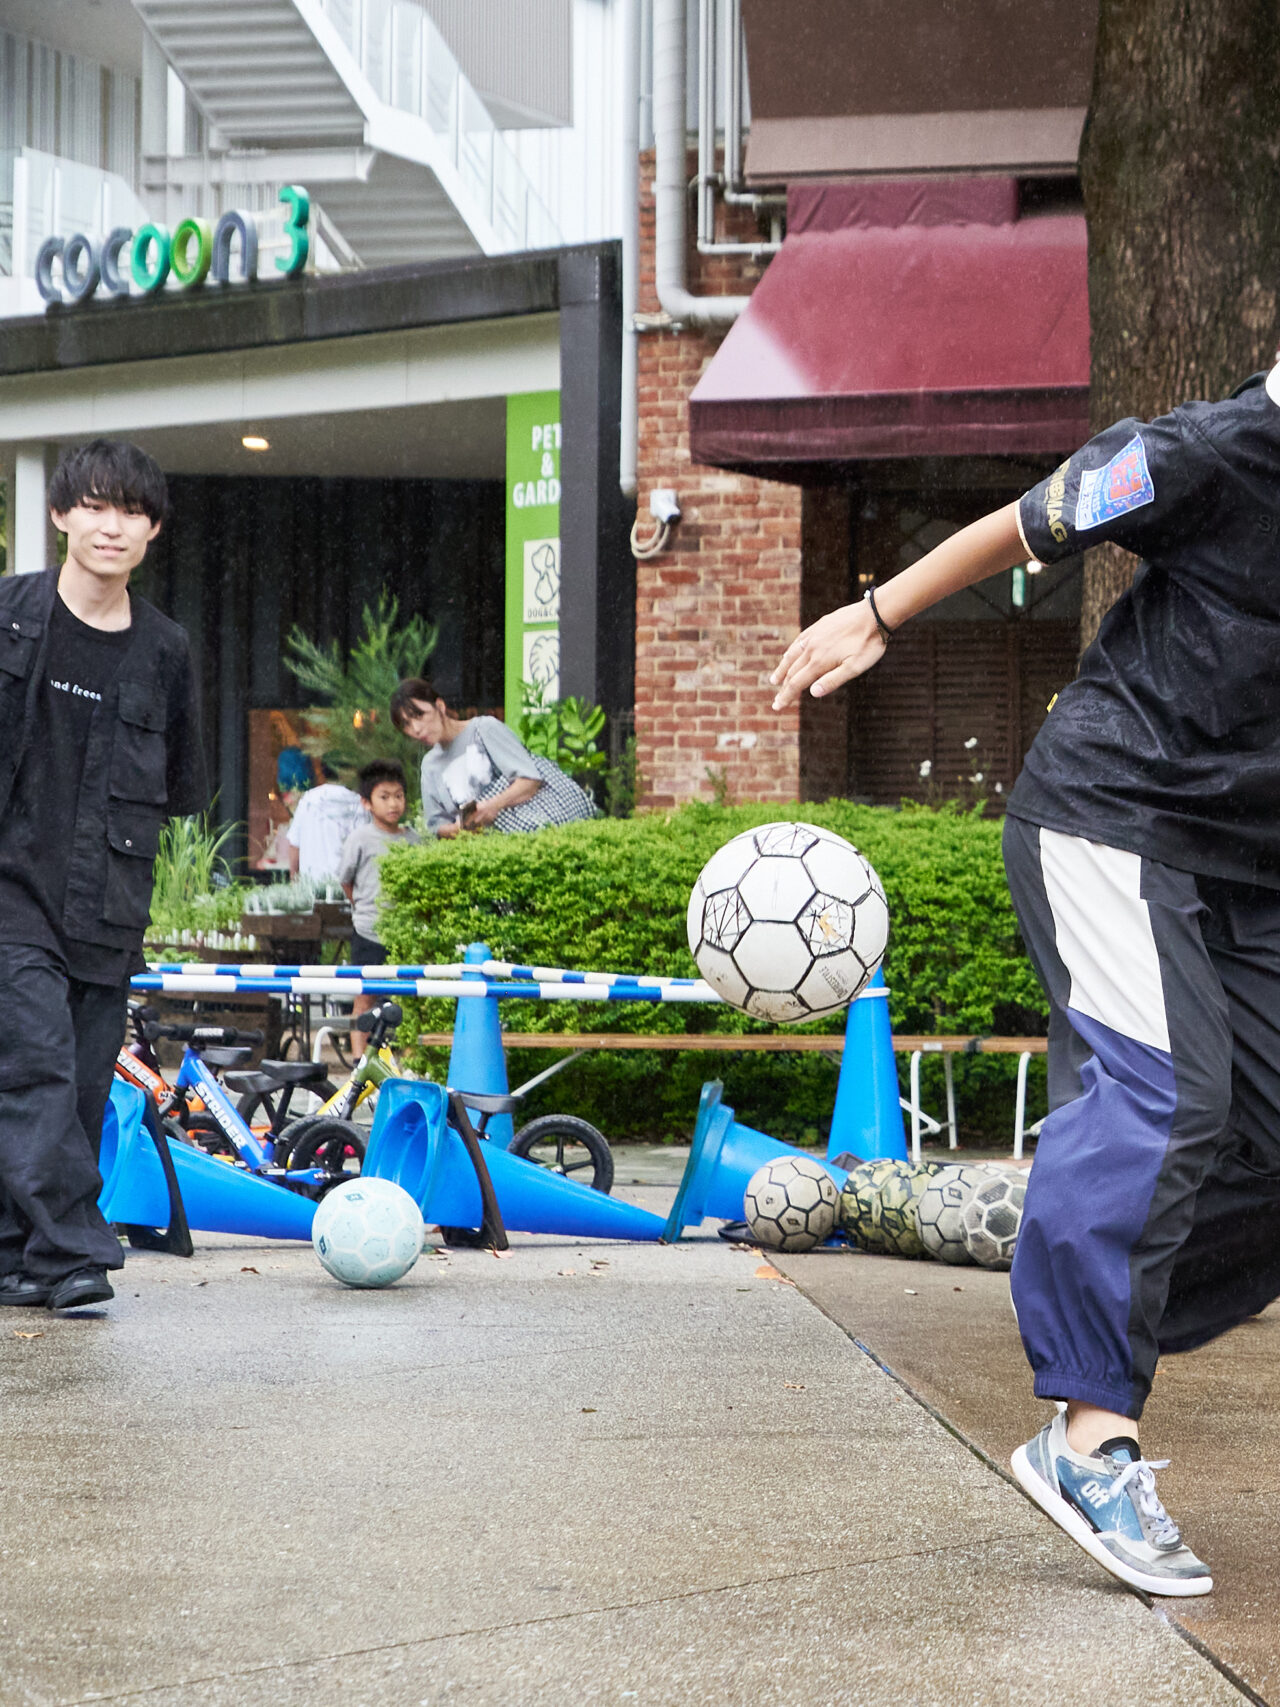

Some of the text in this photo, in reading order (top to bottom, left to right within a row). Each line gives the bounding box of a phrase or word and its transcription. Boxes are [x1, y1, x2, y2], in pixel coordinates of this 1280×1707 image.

[35, 184, 310, 304] cocoon 3
[532, 423, 561, 452] PET
[541, 452, 555, 477] &
[195, 1082, 248, 1150] STRIDER
